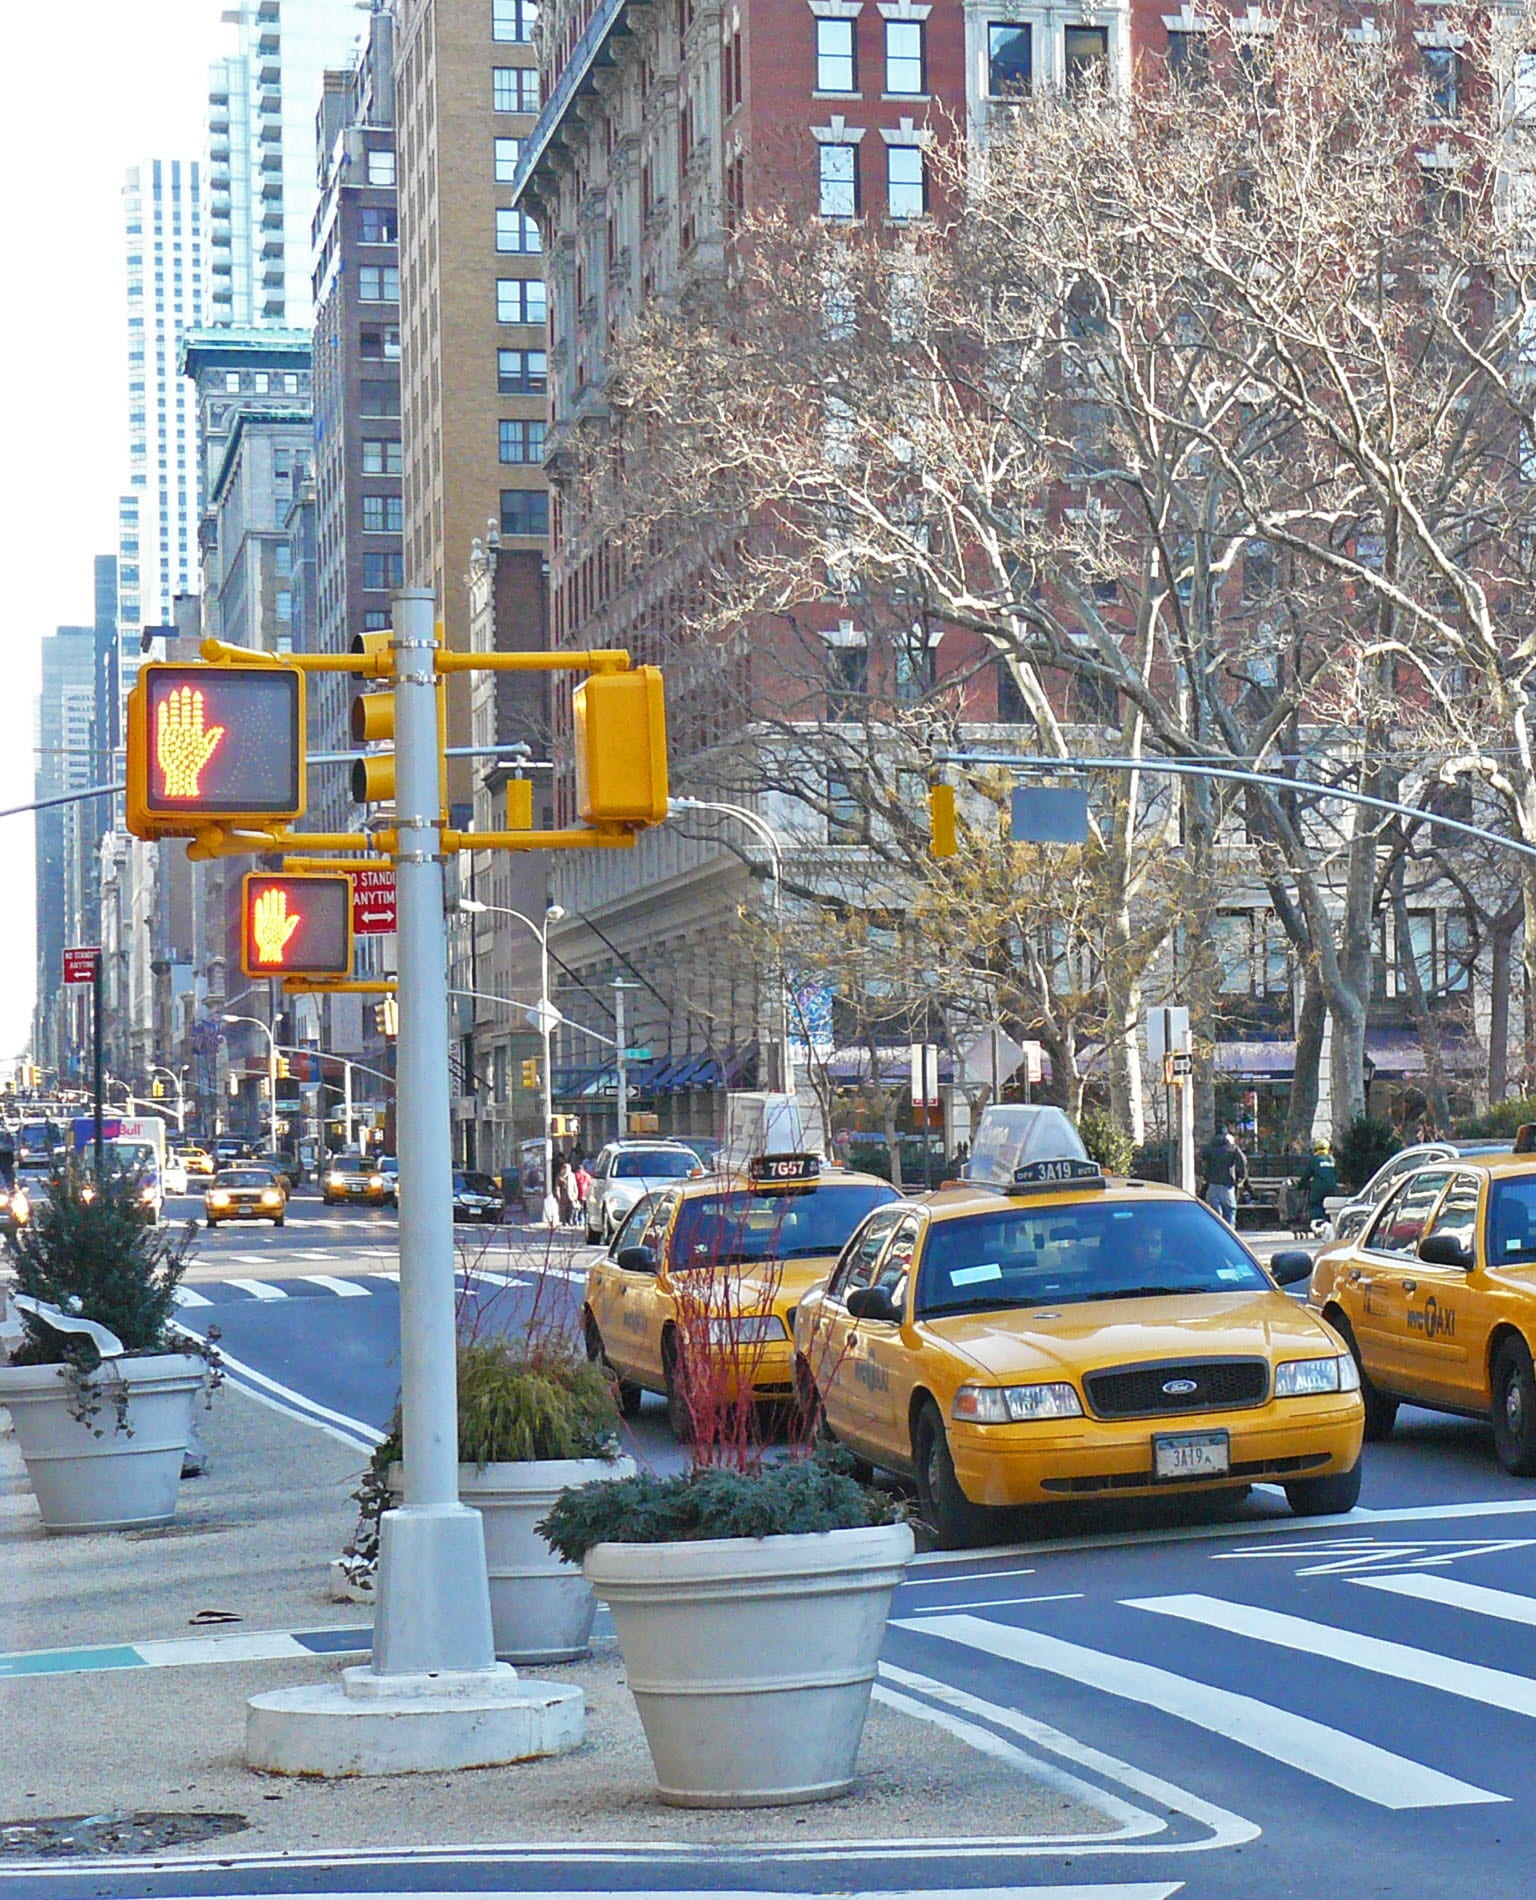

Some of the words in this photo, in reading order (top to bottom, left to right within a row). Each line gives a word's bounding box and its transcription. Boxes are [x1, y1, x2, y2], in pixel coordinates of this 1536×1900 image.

[353, 890, 395, 906] ANYTIM
[769, 1160, 805, 1177] 7G57
[1038, 1162, 1071, 1180] 3A19
